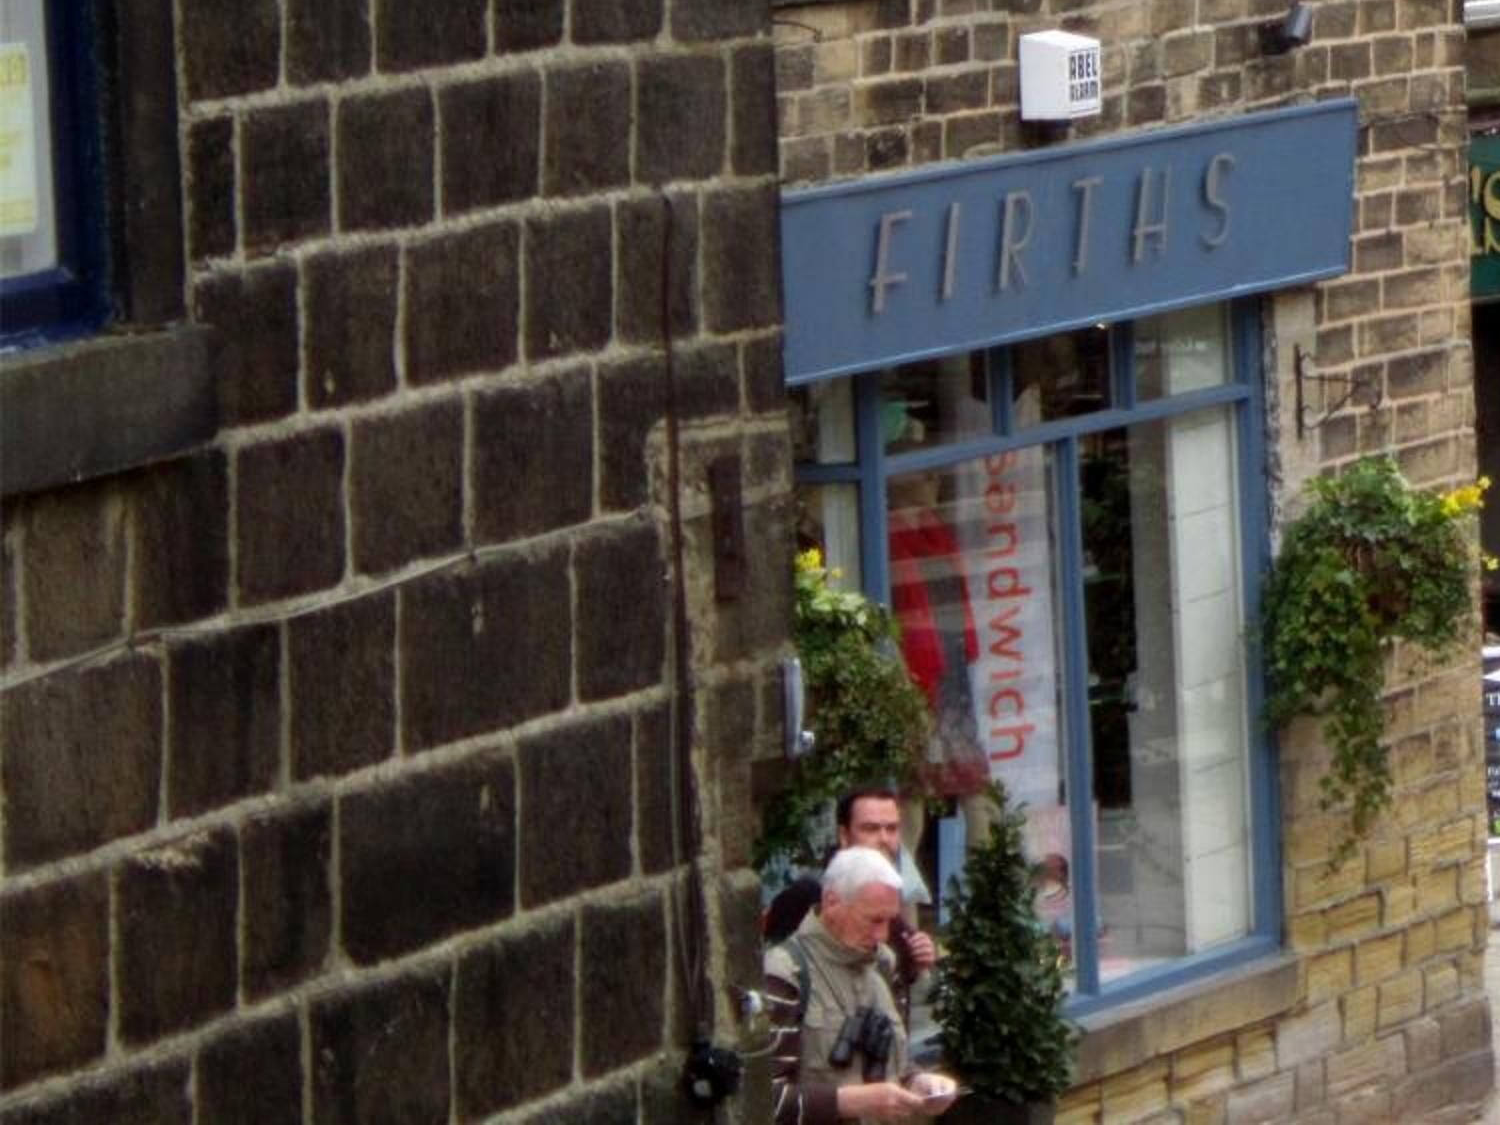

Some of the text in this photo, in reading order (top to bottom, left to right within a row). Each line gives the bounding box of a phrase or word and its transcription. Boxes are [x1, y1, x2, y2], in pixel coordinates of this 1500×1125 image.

[1068, 52, 1098, 81] ABEL
[869, 154, 1235, 313] FIRTHS
[985, 451, 1036, 761] sandwich
